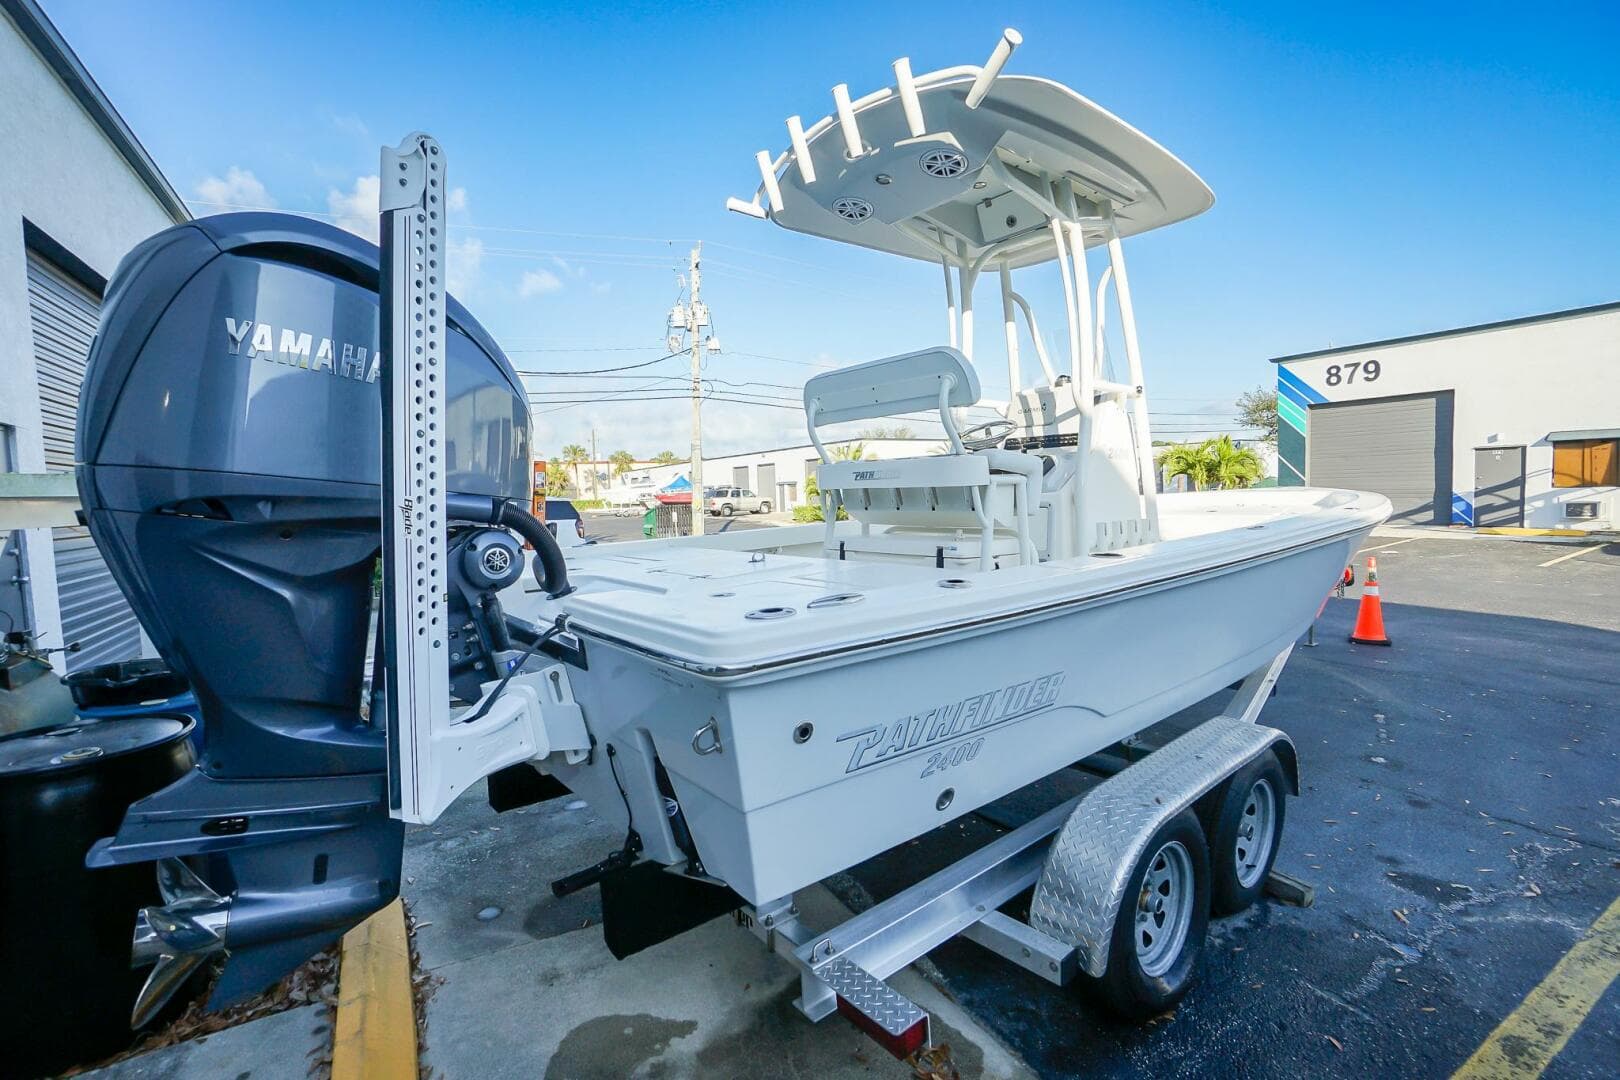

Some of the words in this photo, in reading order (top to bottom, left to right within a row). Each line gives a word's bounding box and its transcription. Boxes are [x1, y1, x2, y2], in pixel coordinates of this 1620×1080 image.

[225, 317, 380, 384] YAMAHA
[1325, 360, 1381, 386] 879
[399, 498, 413, 535] Blade
[836, 671, 1065, 773] PATHFINDER
[920, 737, 985, 779] 2400
